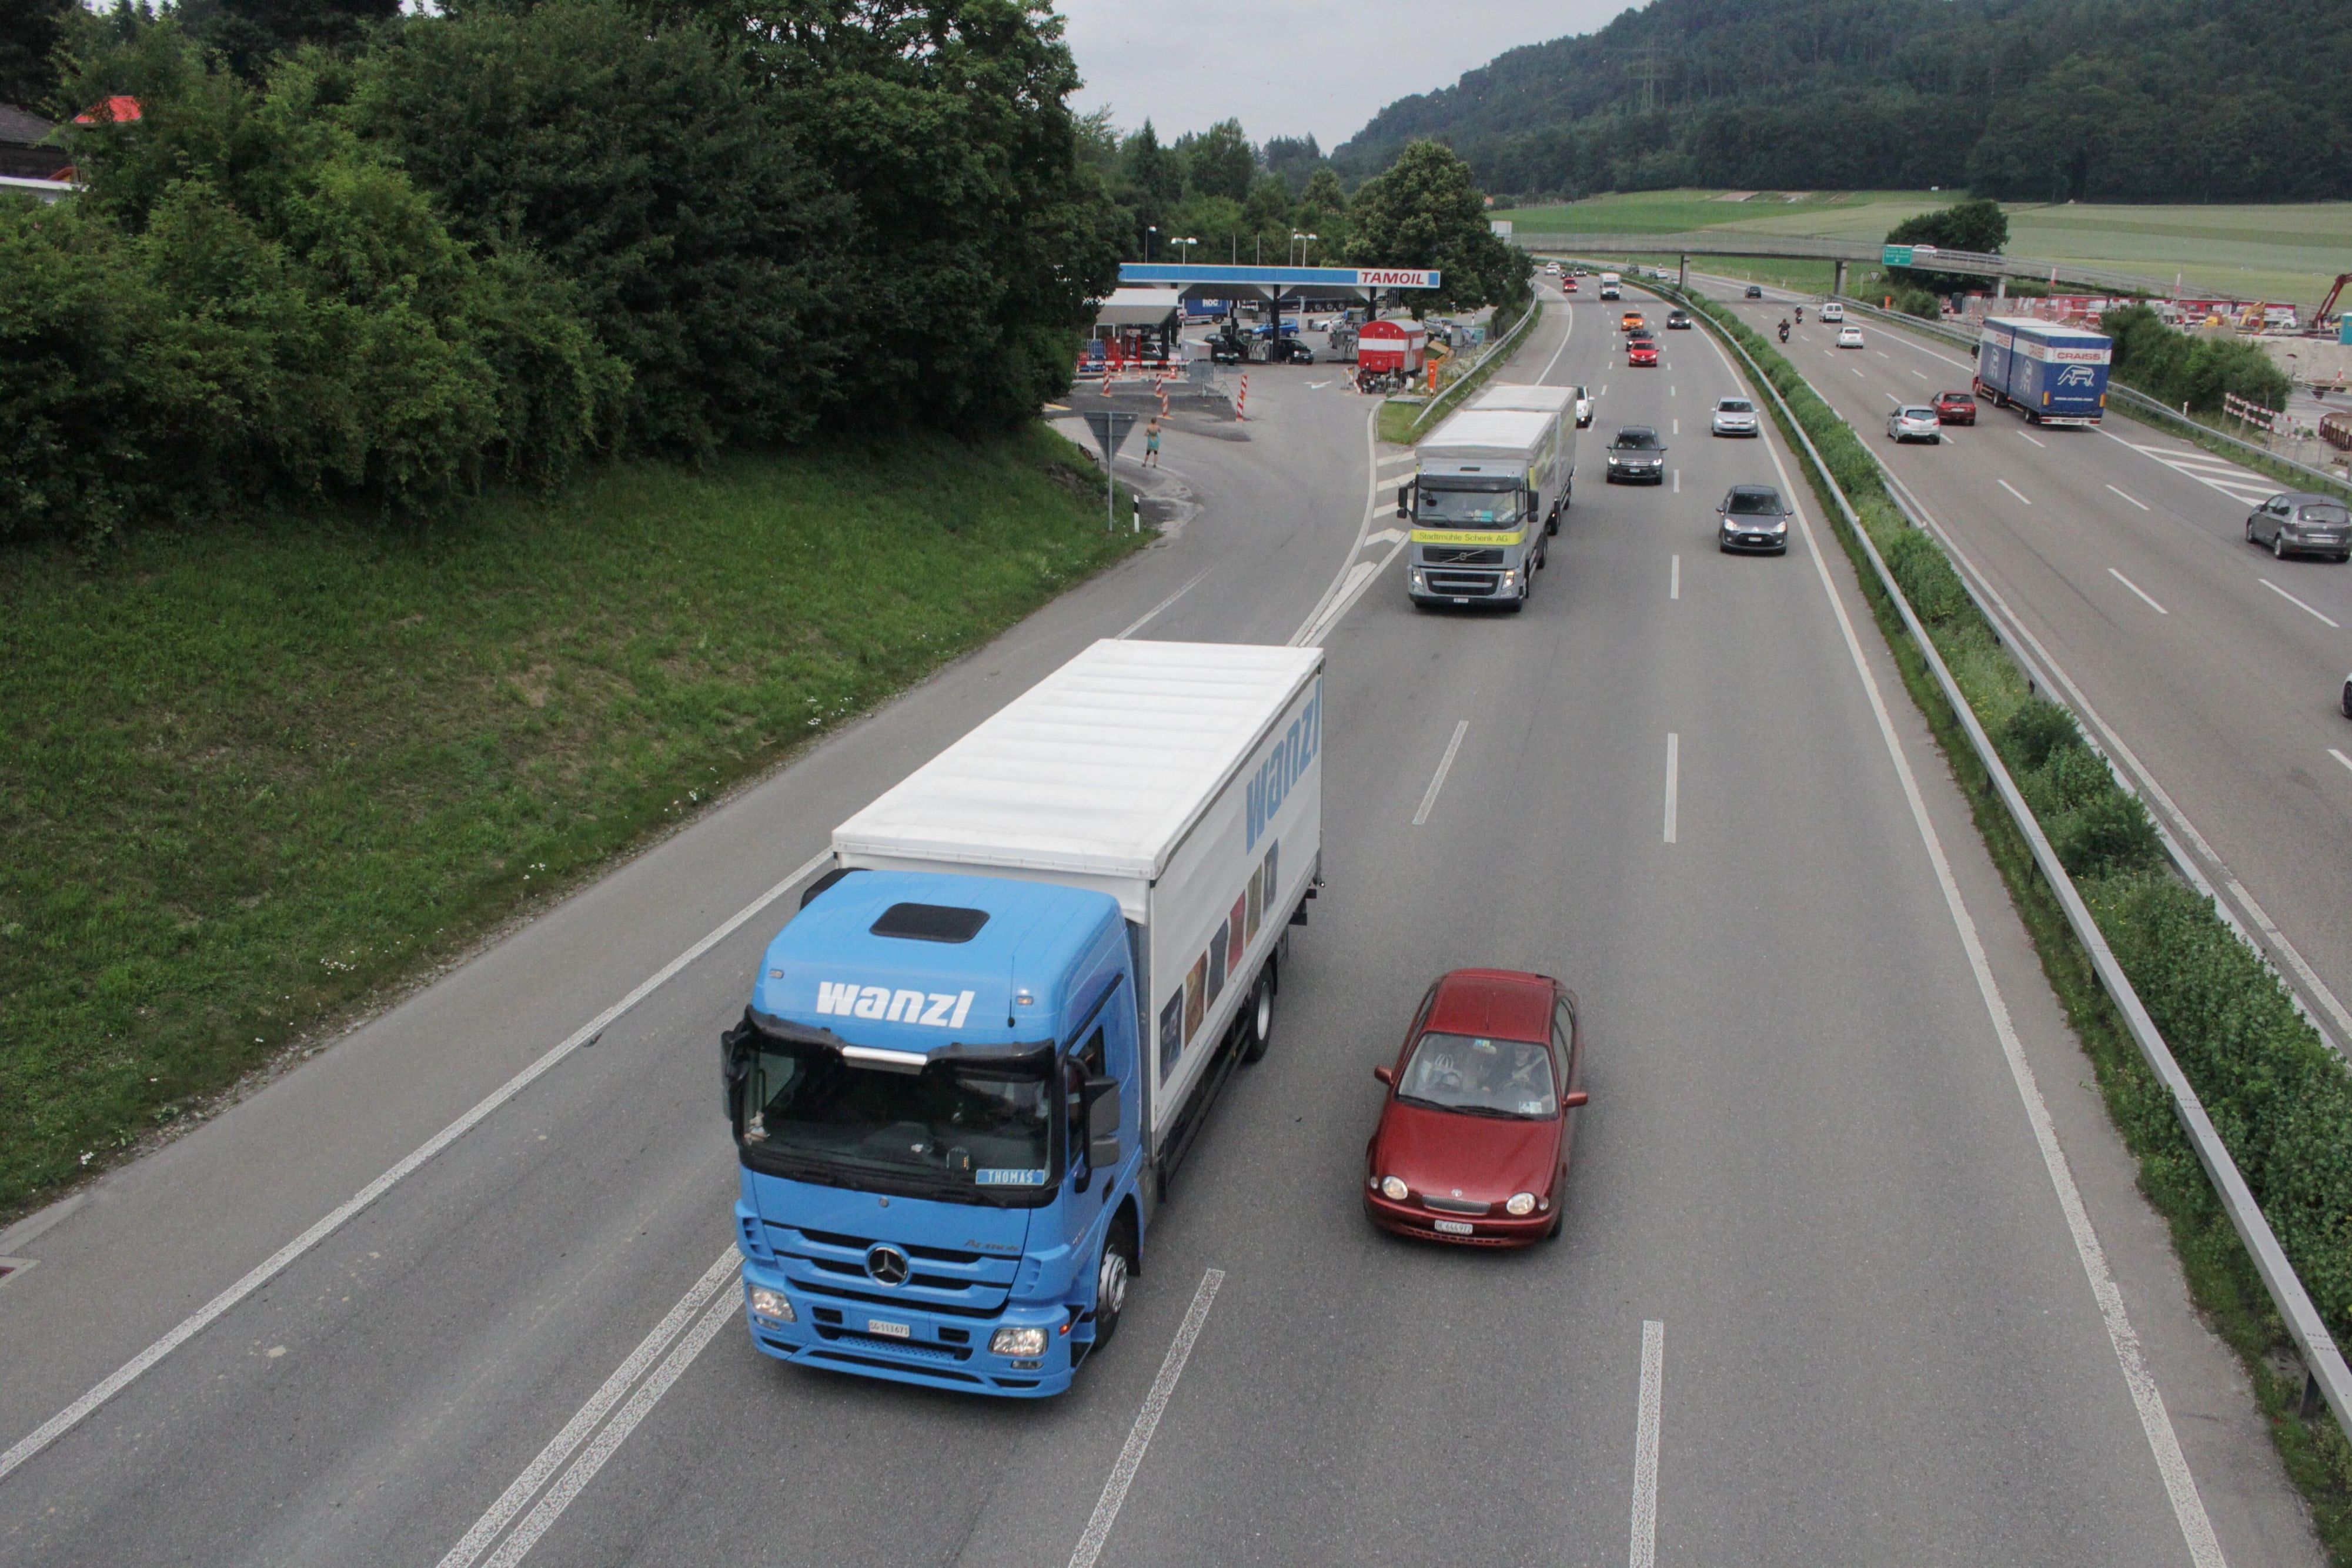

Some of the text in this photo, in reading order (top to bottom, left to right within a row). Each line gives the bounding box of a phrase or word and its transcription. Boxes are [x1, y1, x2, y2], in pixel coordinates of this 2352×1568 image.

[1362, 272, 1424, 285] TAMOIL
[2057, 352, 2101, 360] CRAISS
[1465, 534, 1494, 542] Schenk
[1247, 677, 1321, 855] wanzl
[816, 981, 975, 1029] wanzl
[988, 1171, 1034, 1183] THOMAS
